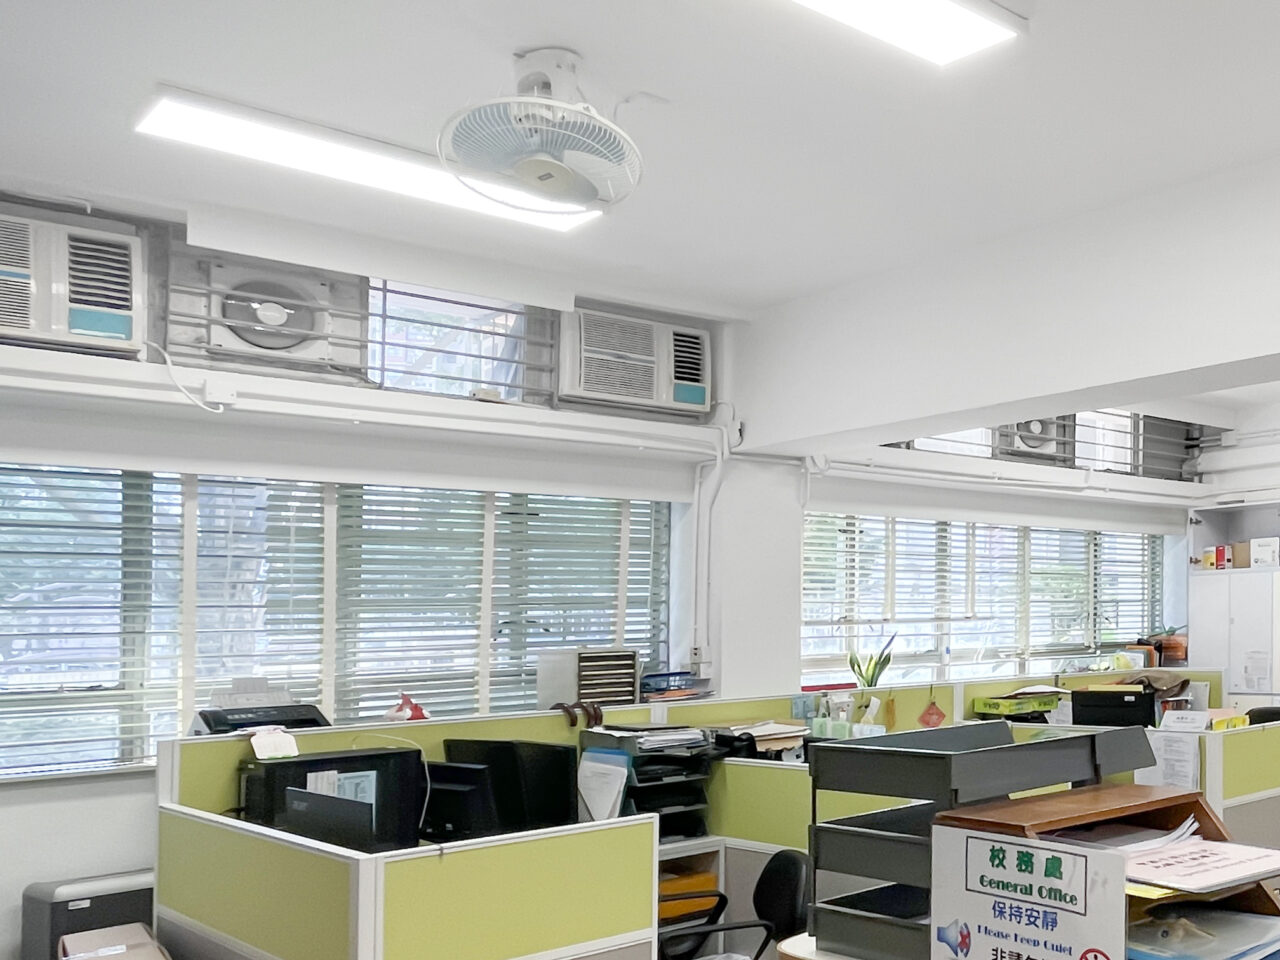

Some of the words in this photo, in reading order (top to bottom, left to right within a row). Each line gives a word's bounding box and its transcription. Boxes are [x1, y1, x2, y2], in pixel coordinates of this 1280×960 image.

[989, 844, 1063, 880] 校務處
[979, 874, 1033, 897] General
[1037, 884, 1078, 906] Office
[992, 900, 1058, 932] 保持安靜
[977, 924, 1011, 941] Please
